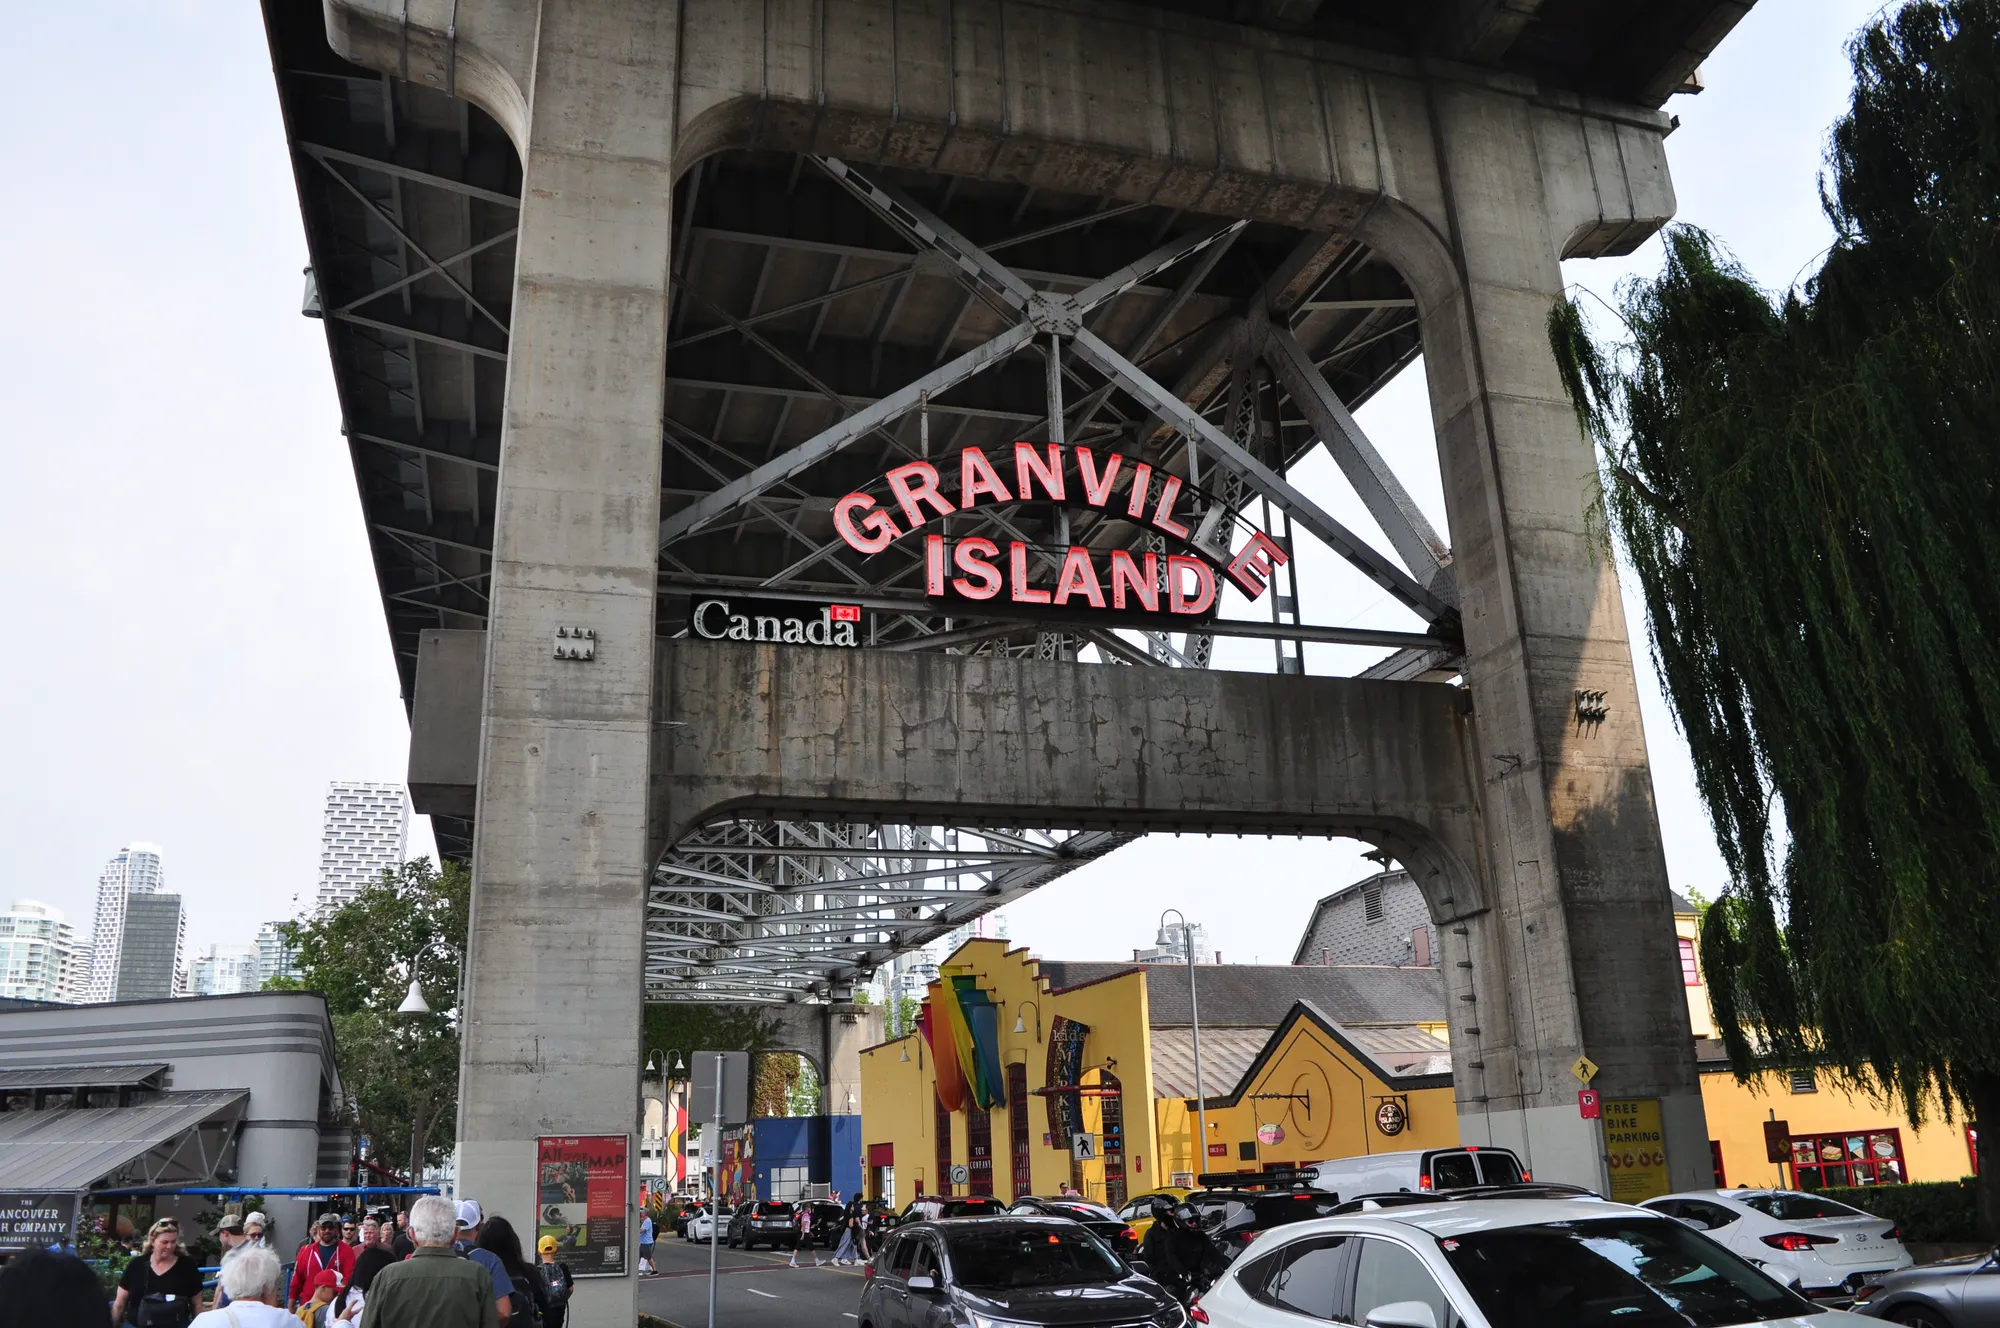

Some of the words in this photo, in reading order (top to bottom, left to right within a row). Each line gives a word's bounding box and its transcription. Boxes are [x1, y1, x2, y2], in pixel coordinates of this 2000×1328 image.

[832, 442, 1290, 602] GRANVILLE
[927, 534, 1217, 614] ISLAND
[693, 600, 859, 647] Canada
[1053, 1029, 1086, 1041] kids
[1606, 1103, 1638, 1114] FREE
[1607, 1118, 1637, 1129] BIKE
[1609, 1131, 1660, 1143] PARKING
[541, 1148, 562, 1161] All
[975, 1146, 985, 1156] TOY
[588, 1154, 625, 1168] MAP
[970, 1160, 991, 1169] COMPANY
[14, 1222, 66, 1233] COMPANY
